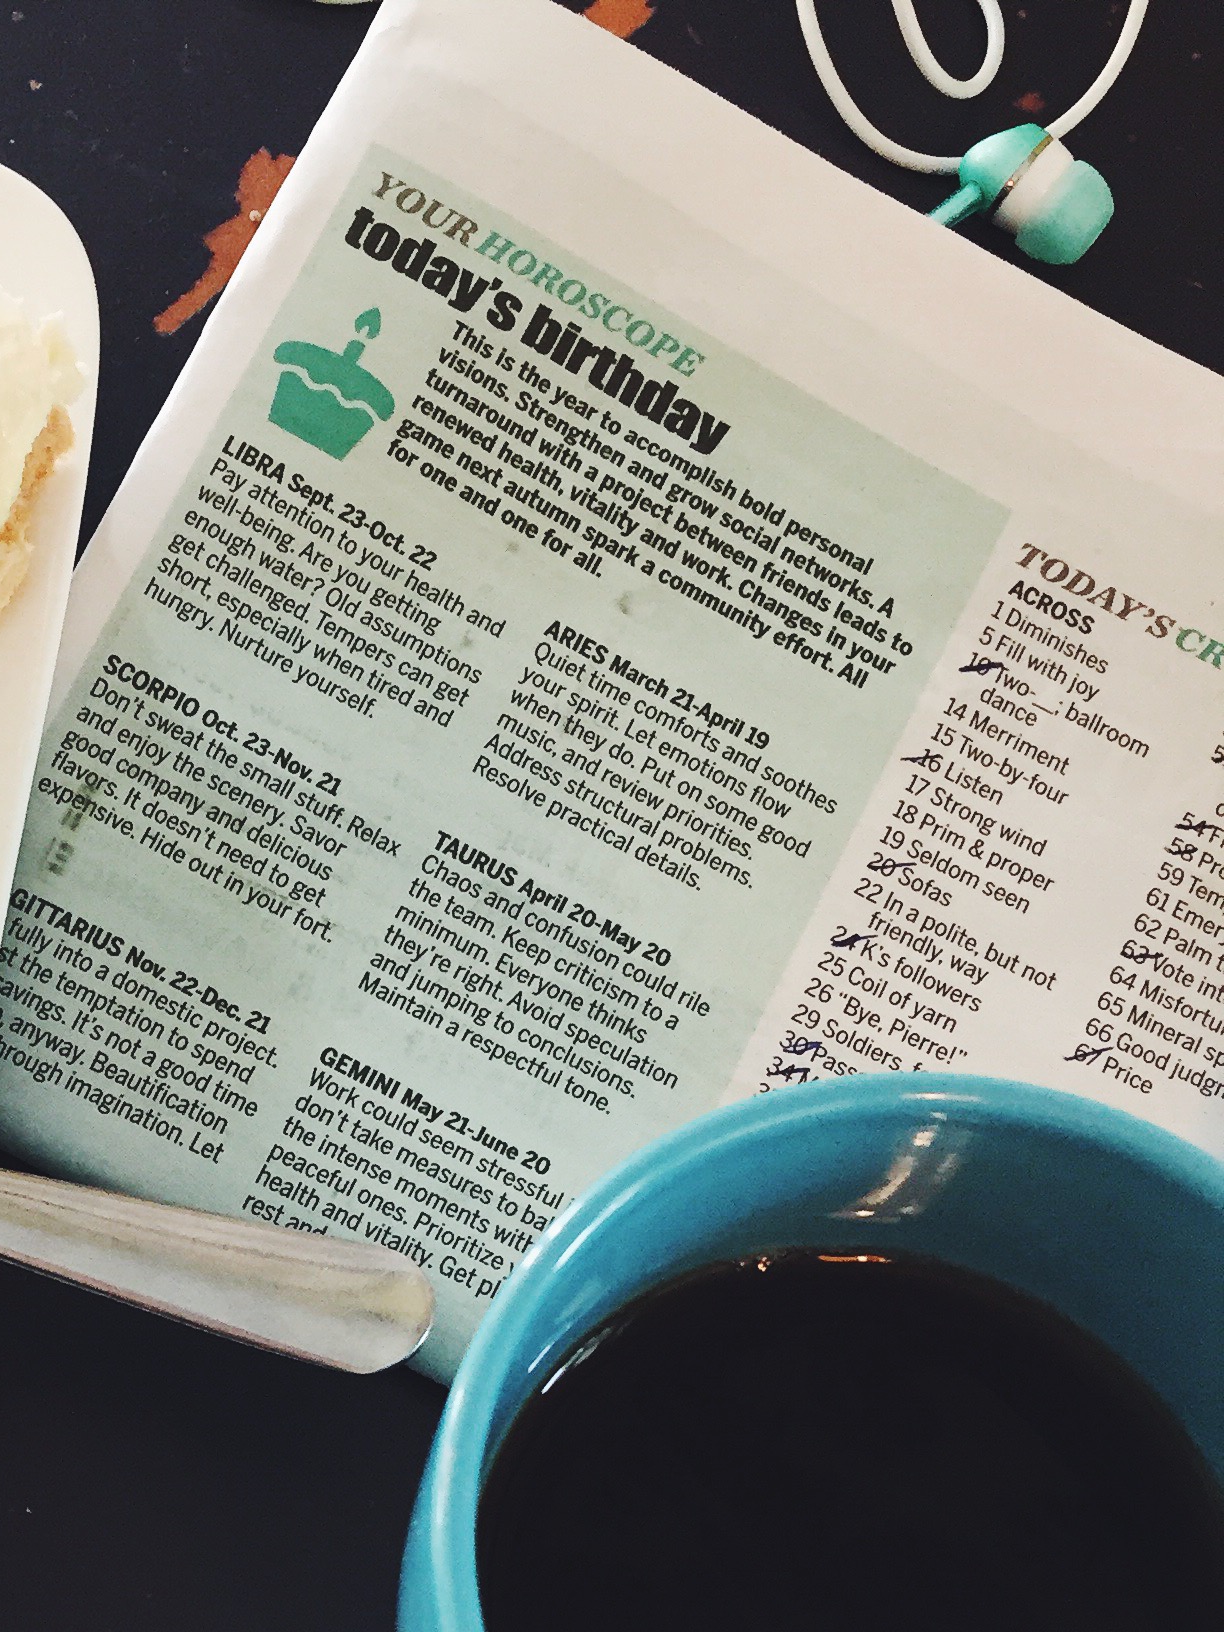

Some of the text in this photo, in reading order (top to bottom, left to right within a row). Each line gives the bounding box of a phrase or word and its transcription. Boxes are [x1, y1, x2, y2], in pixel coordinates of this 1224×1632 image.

[344, 205, 732, 456] today's birthday
[371, 171, 707, 378] YOUR HOROSCOPE
[221, 434, 438, 572] LIBRA Sept. 23-Oct. 22
[438, 346, 895, 620] visions. Strengthen and grow social networks. A
[452, 319, 875, 576] This is the year to accomplish bold personal
[209, 457, 507, 639] Pay attention to your health and
[411, 394, 897, 675] renewed health, vitality and work. Changes in your
[1014, 542, 1178, 639] TODAY'S
[978, 625, 1101, 703] 5 Fill with joy
[990, 599, 1109, 674] 1 Diminishes
[1007, 579, 1096, 635] ACROSS
[102, 653, 342, 797] SCORPIO Oct. 23-Nov. 21
[543, 619, 770, 750] ARIES March 21-April 19
[942, 696, 1070, 777] 14 Merriment
[75, 705, 348, 857] and enjoy the scenery. Savor
[471, 754, 701, 892] Resolve practical details.
[483, 733, 753, 890] Address structural problems.
[904, 773, 1048, 857] 17 Strong wind
[930, 722, 1070, 805] 15 Two-by-four
[434, 829, 672, 967] TAURUS April 20-May 20
[394, 905, 648, 1044] minimum. Everyone thinks
[817, 950, 958, 1034] 25 Coil of yarn
[1097, 991, 1204, 1055] 65 Mineral
[319, 1046, 552, 1176] GEMINI May 21-June 20
[1085, 1017, 1172, 1072] 66 Good
[64, 1070, 184, 1147] imagination.
[188, 1131, 225, 1165] Let
[309, 1066, 565, 1210] Work could seem stressful
